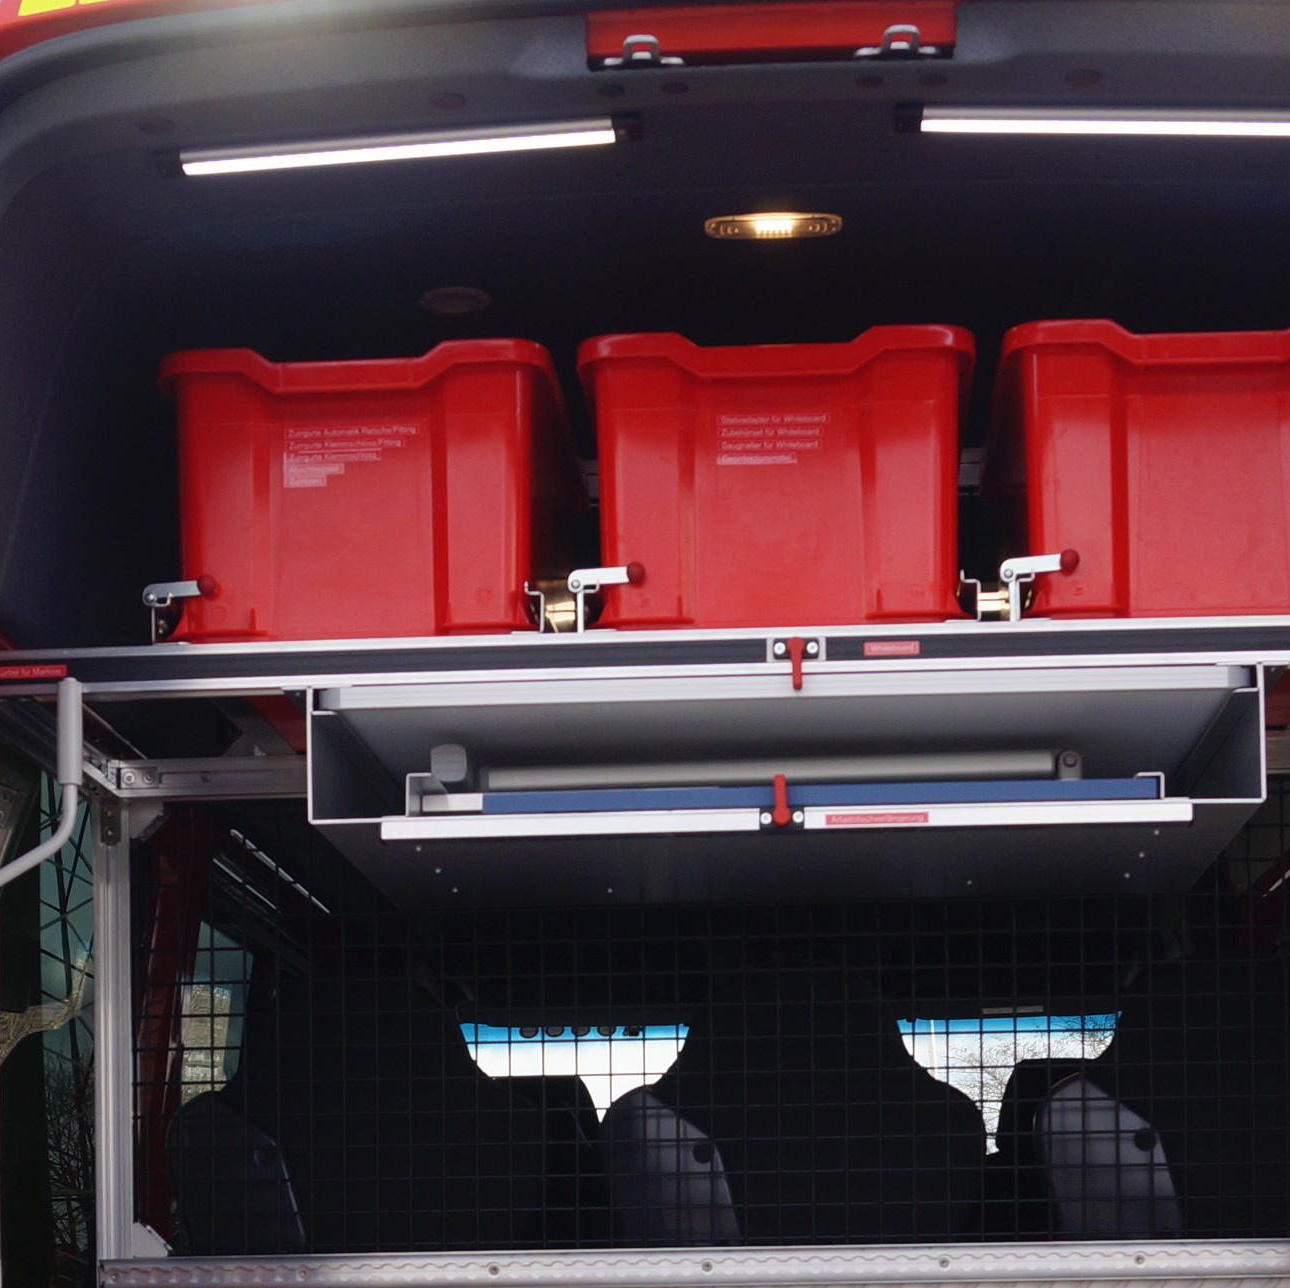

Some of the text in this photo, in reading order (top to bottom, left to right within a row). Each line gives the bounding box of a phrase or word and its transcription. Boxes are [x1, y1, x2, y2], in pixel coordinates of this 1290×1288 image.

[784, 414, 826, 422] Whiteboard
[323, 428, 359, 436] Automatik
[777, 427, 819, 435] Whiteboard
[776, 440, 818, 448] Whiteboard
[871, 643, 914, 652] Whiteboard
